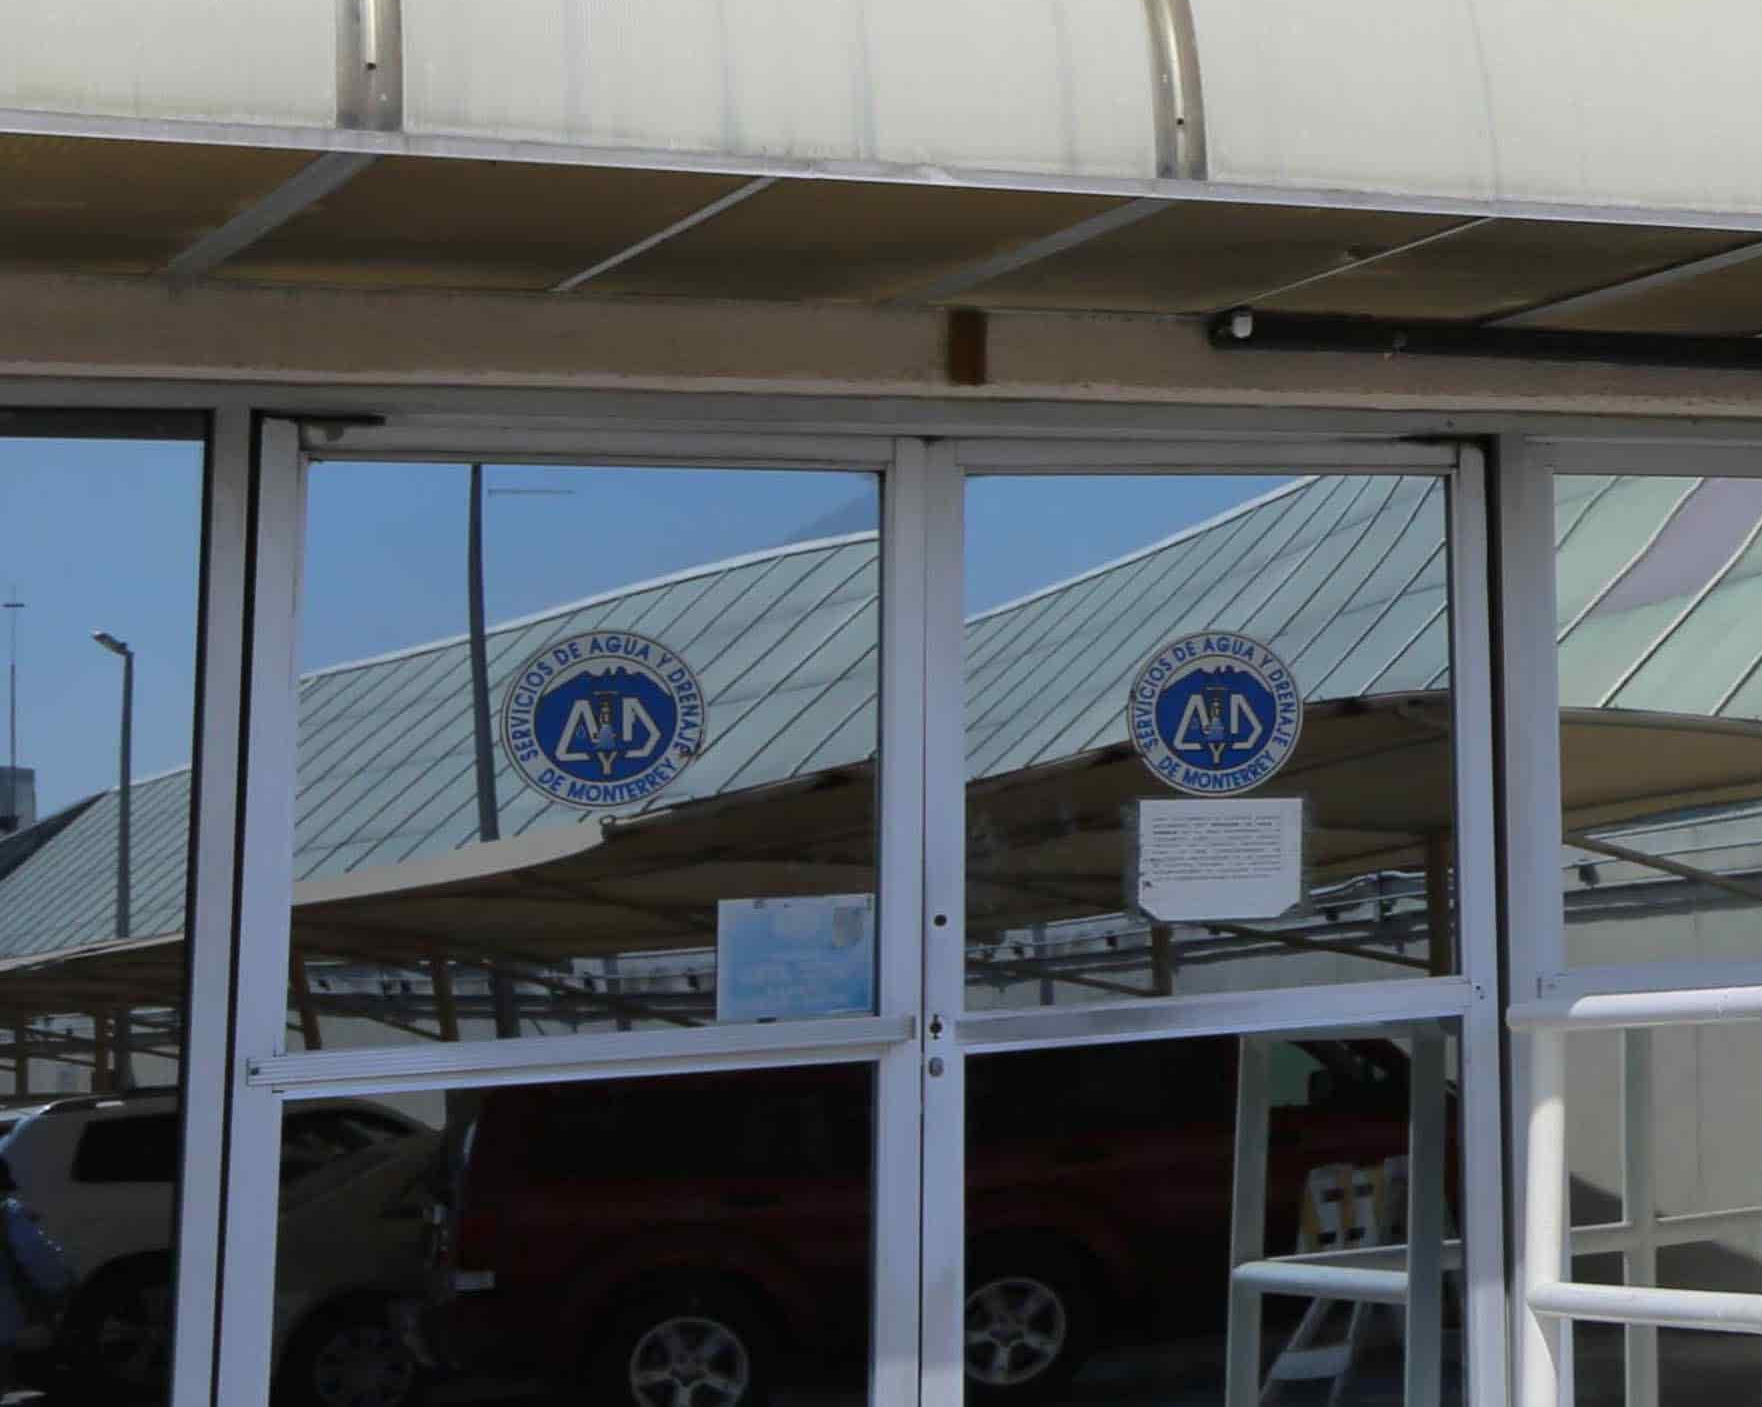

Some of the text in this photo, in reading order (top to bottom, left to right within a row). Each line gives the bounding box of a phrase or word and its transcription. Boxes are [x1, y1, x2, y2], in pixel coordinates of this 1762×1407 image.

[511, 636, 700, 762] SERVICIOS DE AGUA Y DRENAJE
[1136, 637, 1297, 751] SERVICIOS DE AGUA Y DRENAJE
[538, 758, 677, 803] DE MONTERREY
[1158, 751, 1275, 790] DE MONTERREY
